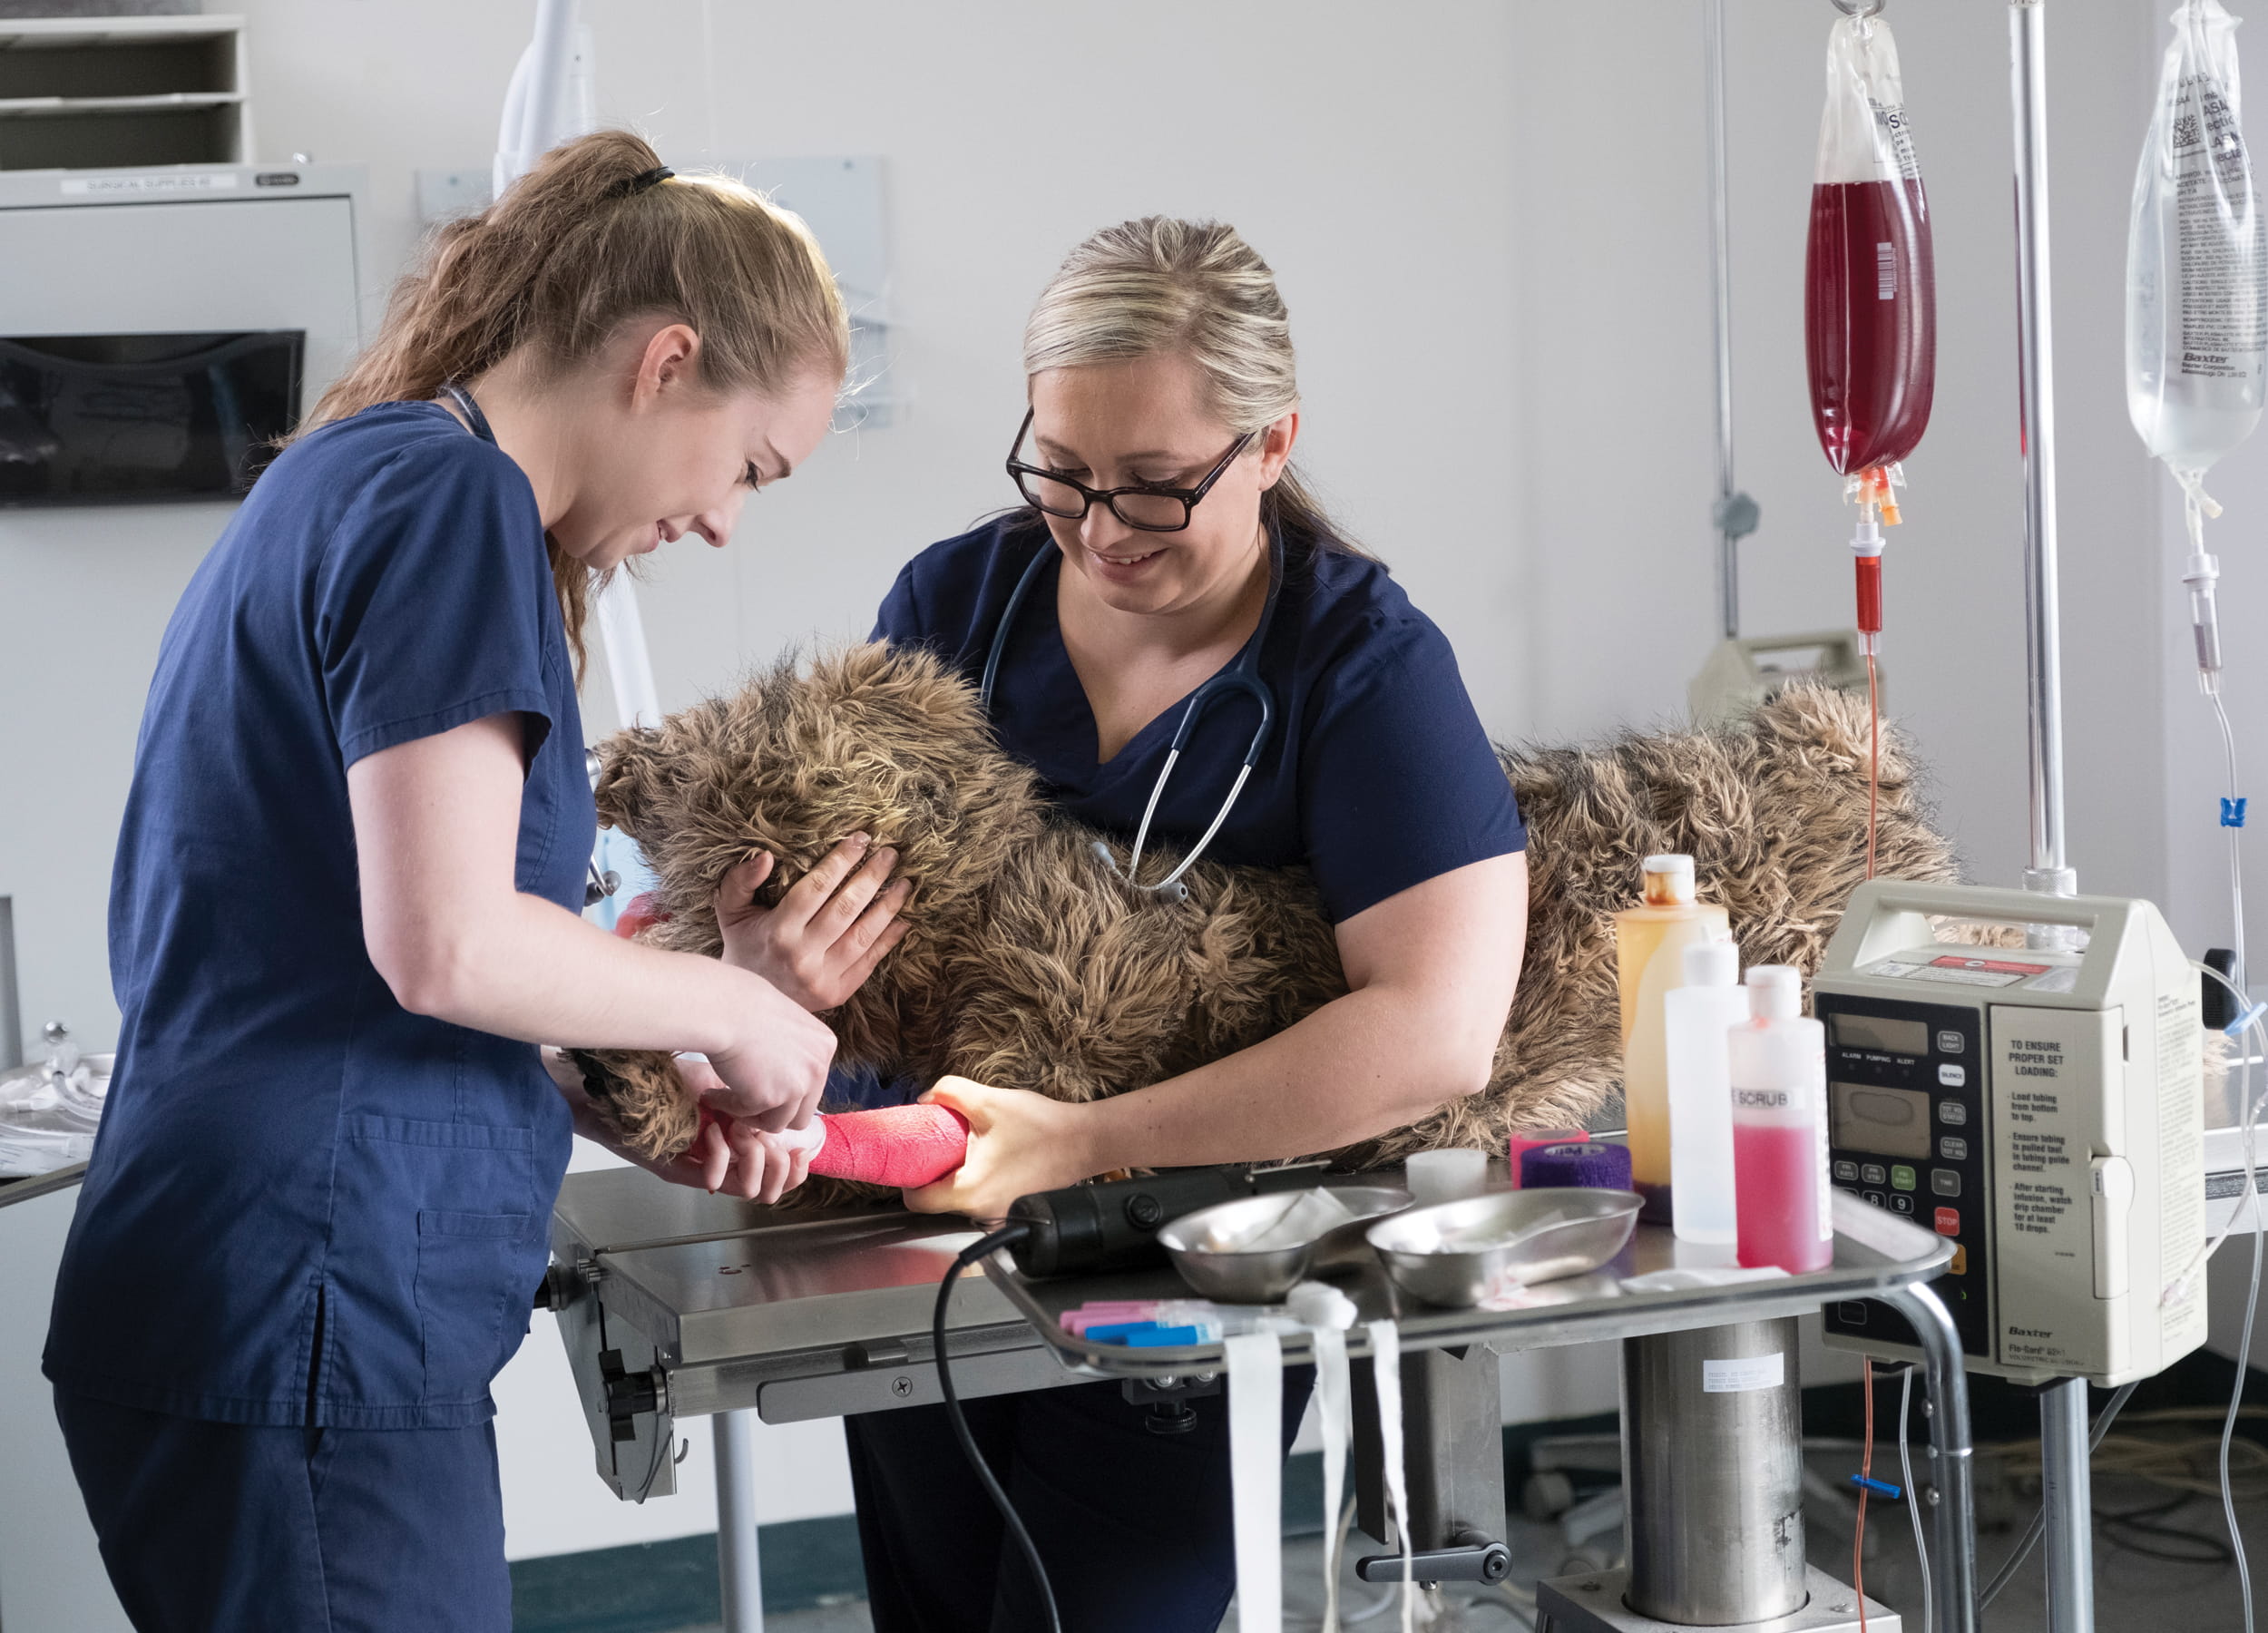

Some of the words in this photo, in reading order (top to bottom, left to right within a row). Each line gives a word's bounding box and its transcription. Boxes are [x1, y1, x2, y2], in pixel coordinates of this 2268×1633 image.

[2183, 352, 2229, 364] Baxter
[2010, 1040, 2023, 1051] TO
[2025, 1041, 2061, 1052] ENSURE
[1842, 1051, 1862, 1060] ALARM
[1865, 1054, 1892, 1063] PUMPING
[2009, 1052, 2045, 1064] PROPER
[2047, 1054, 2064, 1065] SET
[1896, 1058, 1915, 1066] ALERT
[1941, 1071, 1962, 1080] SILENCE
[2015, 1066, 2058, 1078] LOADING:
[1739, 1091, 1788, 1107] SCRUB
[2011, 1091, 2031, 1101] Load
[2032, 1093, 2058, 1104] tubing
[2011, 1102, 2030, 1110] from
[2031, 1103, 2058, 1113] bottom
[2011, 1112, 2019, 1120] to
[2012, 1132, 2039, 1142] Ensure
[2040, 1134, 2066, 1146] tubing
[2021, 1144, 2046, 1153] pulled
[2021, 1153, 2047, 1165] tubing
[2048, 1156, 2070, 1165] guide
[2014, 1182, 2033, 1192] After
[2034, 1184, 2065, 1197] starting
[1870, 1195, 1879, 1206] 8
[1897, 1198, 1906, 1210] 9
[2049, 1196, 2073, 1205] watch
[2014, 1202, 2029, 1213] drip
[2031, 1203, 2065, 1215] chamber
[1937, 1216, 1958, 1226] STOP
[2014, 1212, 2025, 1221] for
[2027, 1214, 2035, 1222] at
[2036, 1214, 2056, 1225] least
[2015, 1222, 2025, 1231] 10
[2009, 1325, 2053, 1338] Baxter
